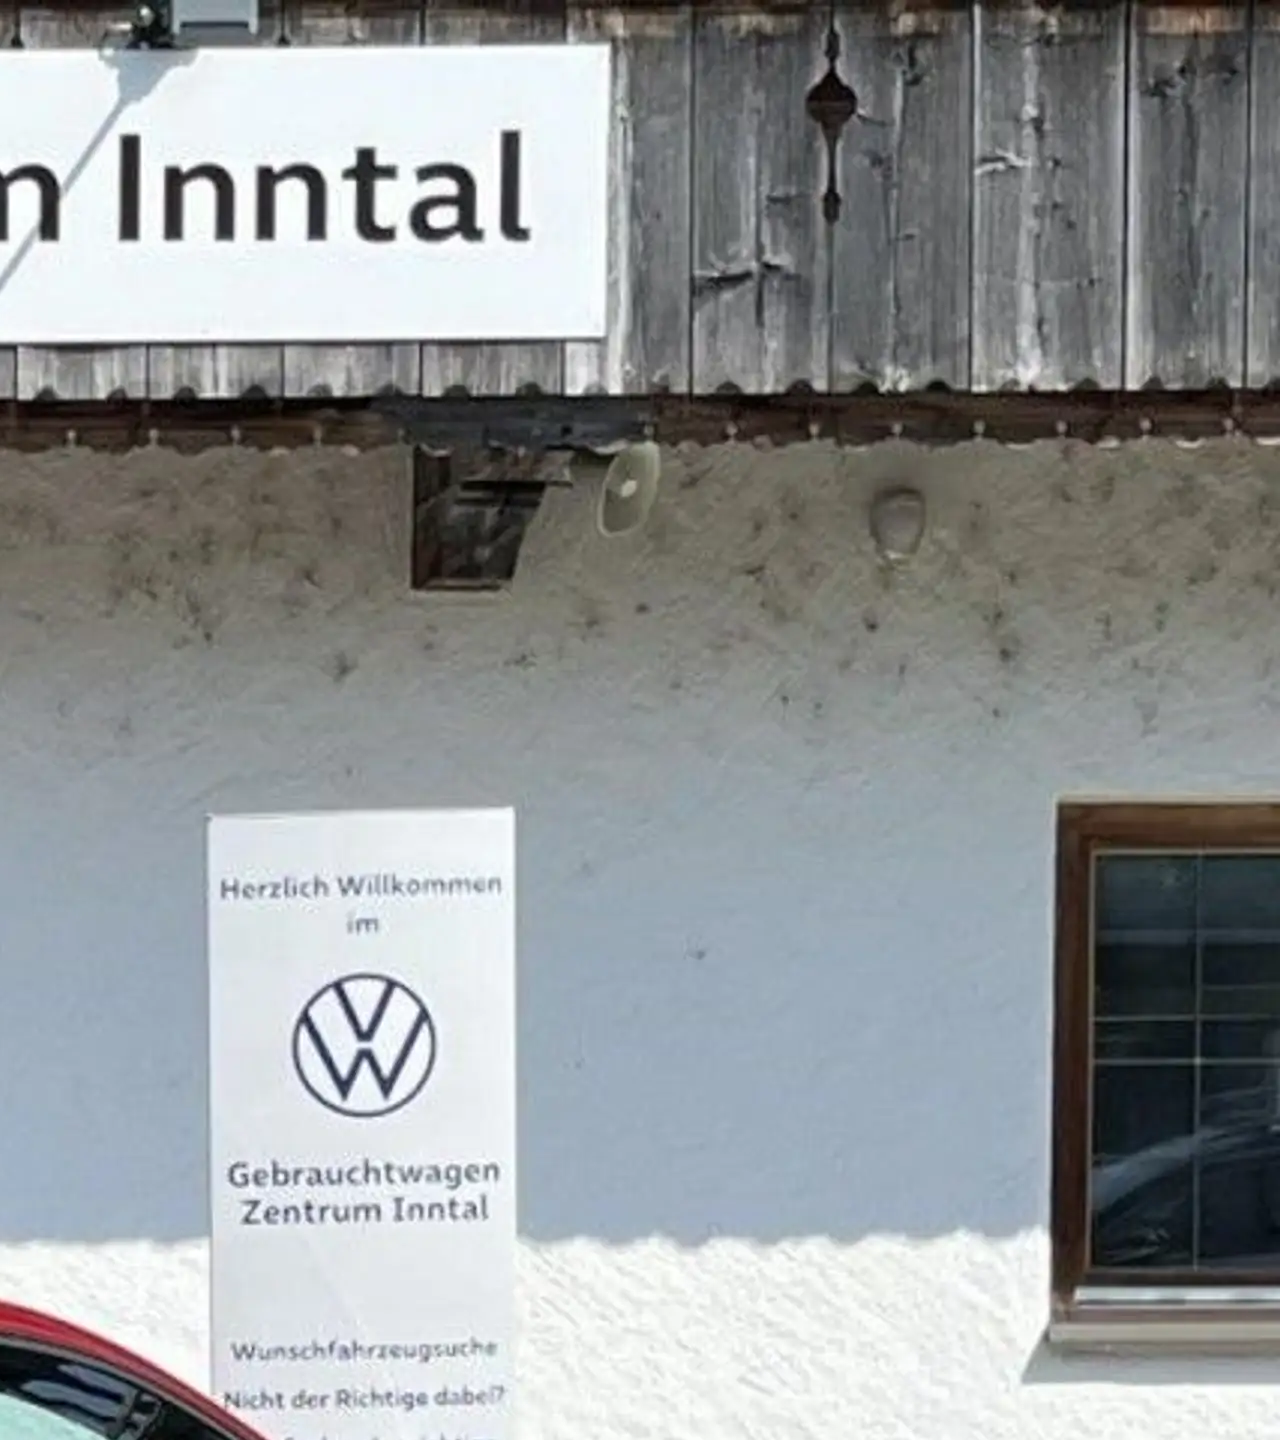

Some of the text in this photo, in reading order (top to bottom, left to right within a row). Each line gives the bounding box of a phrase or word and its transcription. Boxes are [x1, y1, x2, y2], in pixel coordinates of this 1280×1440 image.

[118, 130, 531, 244] Inntal
[220, 875, 502, 900] Herzlich Willkommen
[346, 914, 379, 935] im
[227, 1159, 501, 1190] Gebrauchtwagen
[241, 1195, 489, 1226] Zentrum Inntal
[230, 1338, 500, 1363] Wunschfahrzeugsuche
[224, 1385, 506, 1411] Nicht der Richtige dabei?
